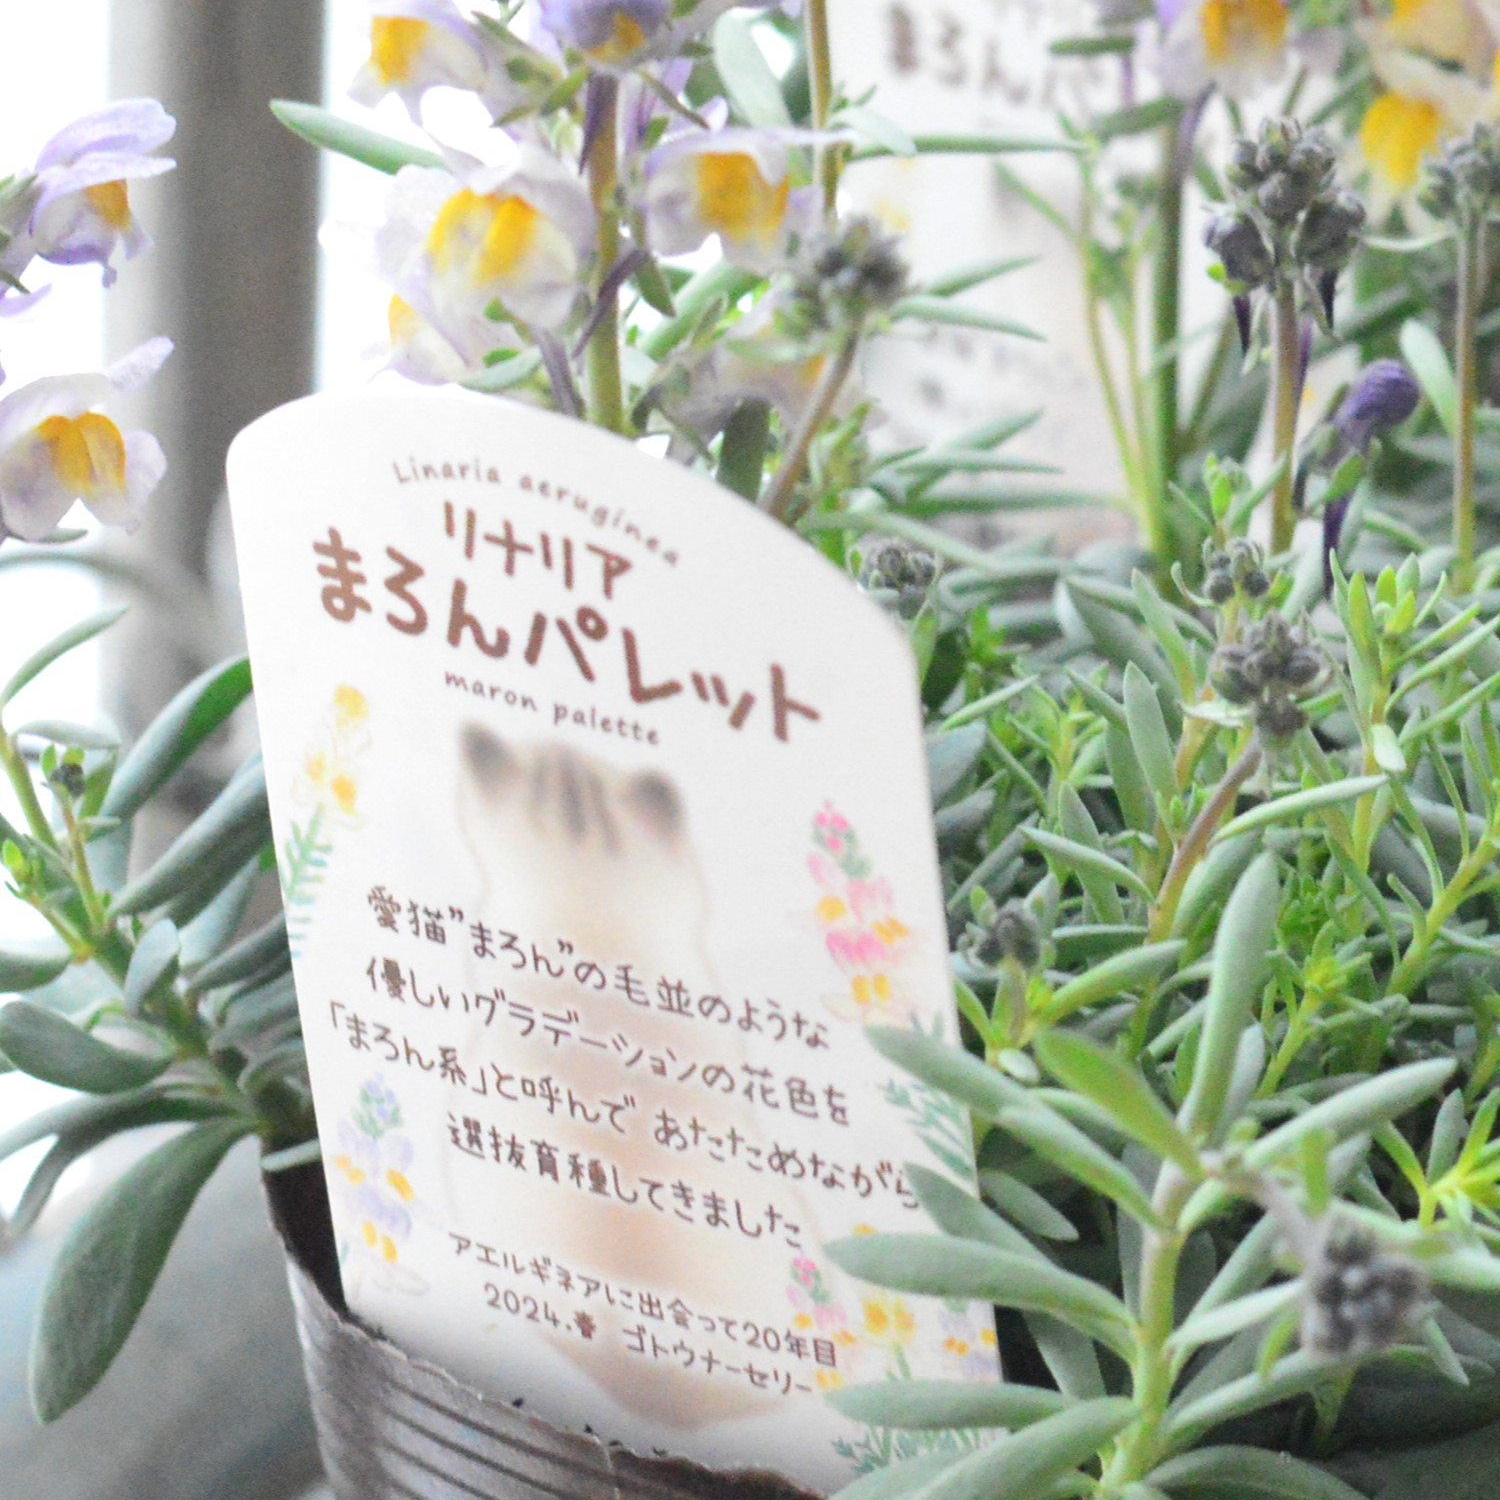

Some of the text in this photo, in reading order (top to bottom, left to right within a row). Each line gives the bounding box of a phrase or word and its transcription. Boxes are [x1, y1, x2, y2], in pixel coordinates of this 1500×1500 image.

[393, 456, 679, 568] Linaria aeruginea
[444, 499, 634, 602] リナリア
[312, 526, 821, 743] まろんパレット
[444, 670, 660, 747] maron palette
[331, 999, 920, 1210] 「まろん系」と呼んで あたためながら
[366, 956, 849, 1126] 優しいグラデーションの花色を
[447, 1111, 802, 1249] 選抜育種してきました
[448, 1232, 837, 1368] アエルギネアに出会って20年目
[621, 1325, 813, 1395] ゴトウナーセリー
